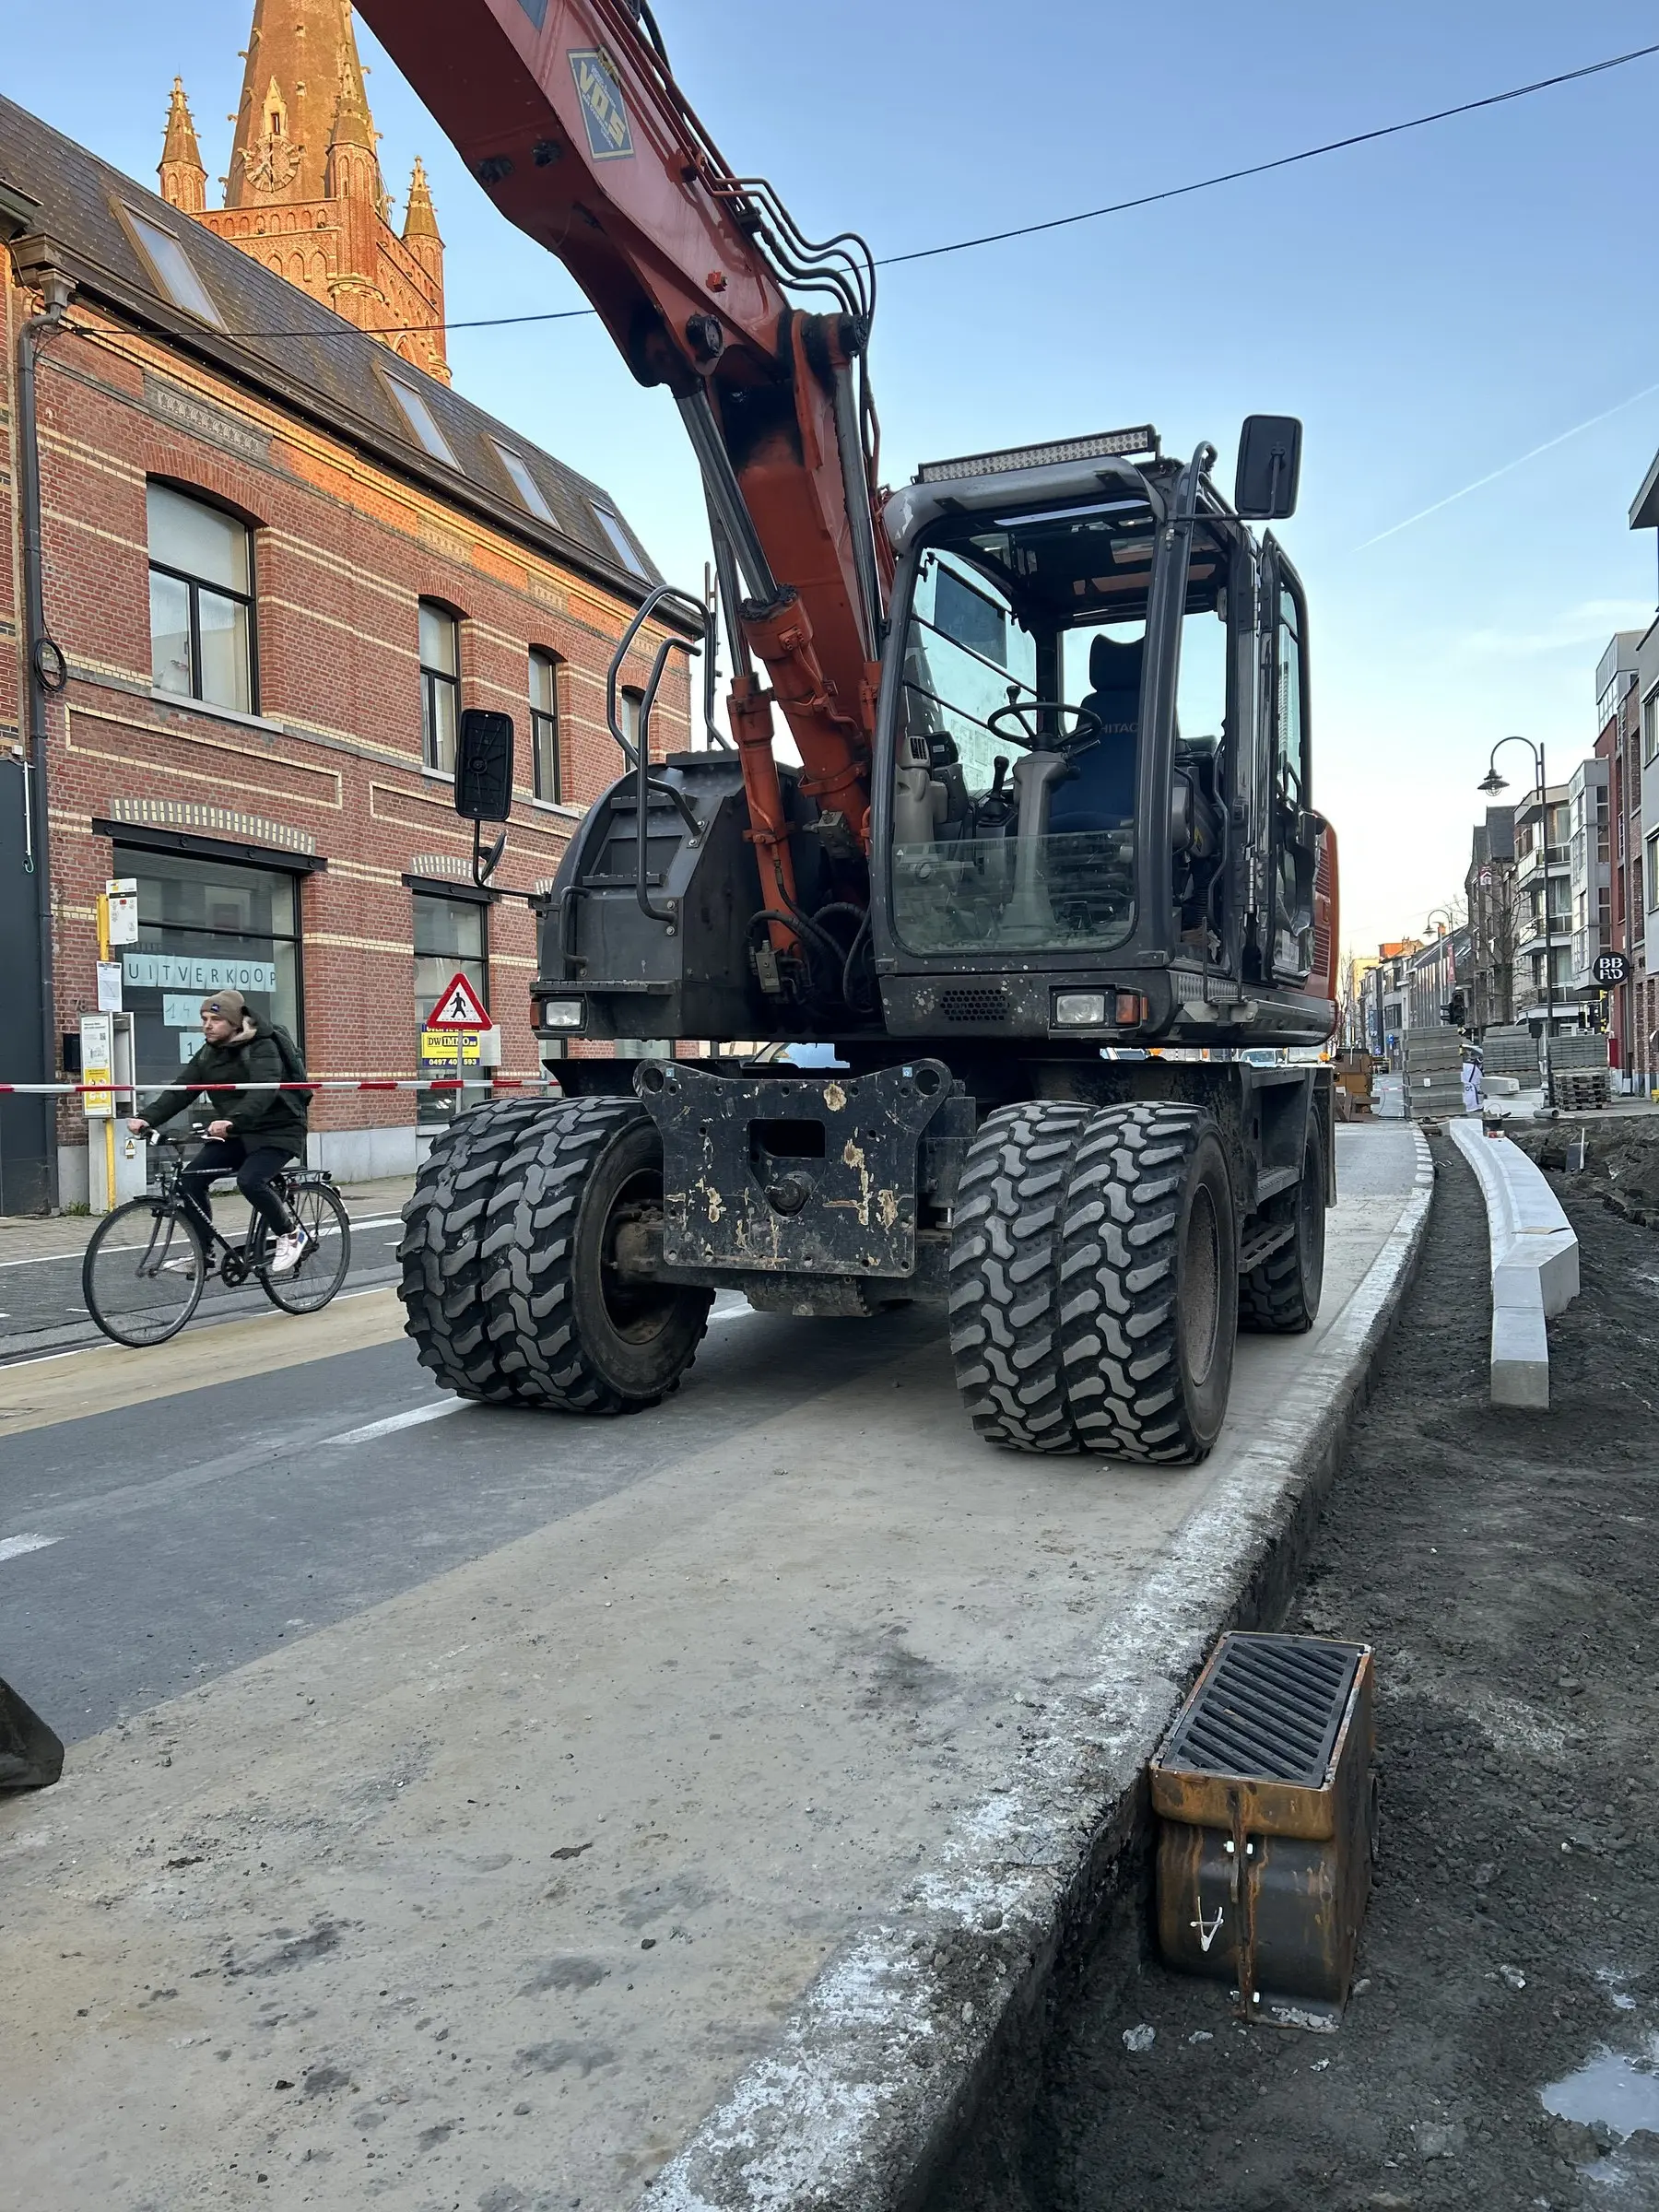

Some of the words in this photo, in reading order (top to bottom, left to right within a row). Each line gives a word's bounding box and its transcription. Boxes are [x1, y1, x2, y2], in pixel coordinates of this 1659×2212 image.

[580, 60, 626, 147] VOS
[128, 963, 276, 985] UITVERKOOP
[73, 999, 87, 1012] 78
